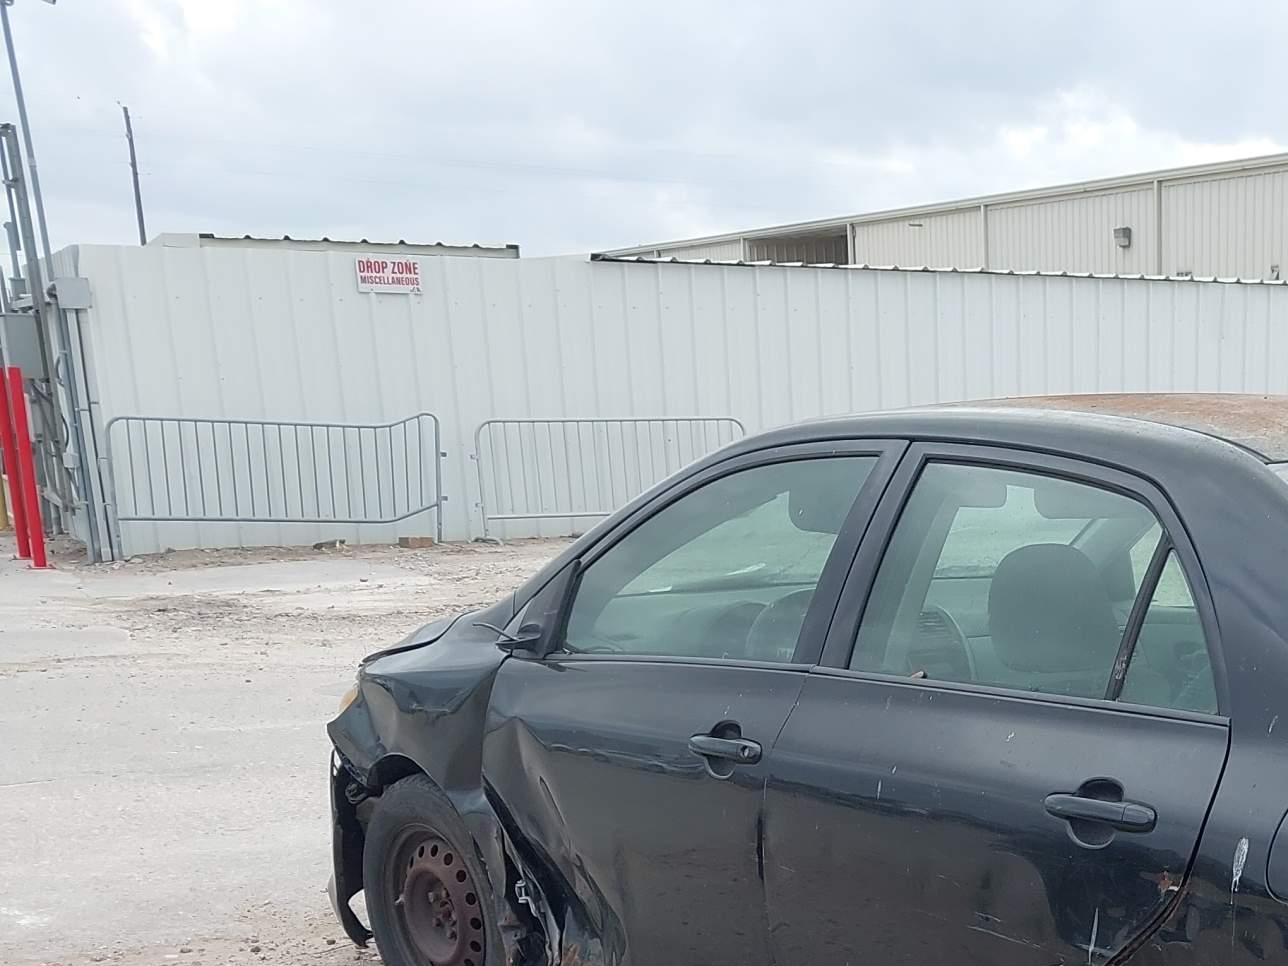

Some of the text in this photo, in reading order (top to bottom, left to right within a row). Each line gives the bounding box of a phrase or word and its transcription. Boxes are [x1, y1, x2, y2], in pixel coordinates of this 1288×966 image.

[358, 260, 419, 275] DROP ZONE
[360, 275, 420, 286] MISCELLANEOUS
